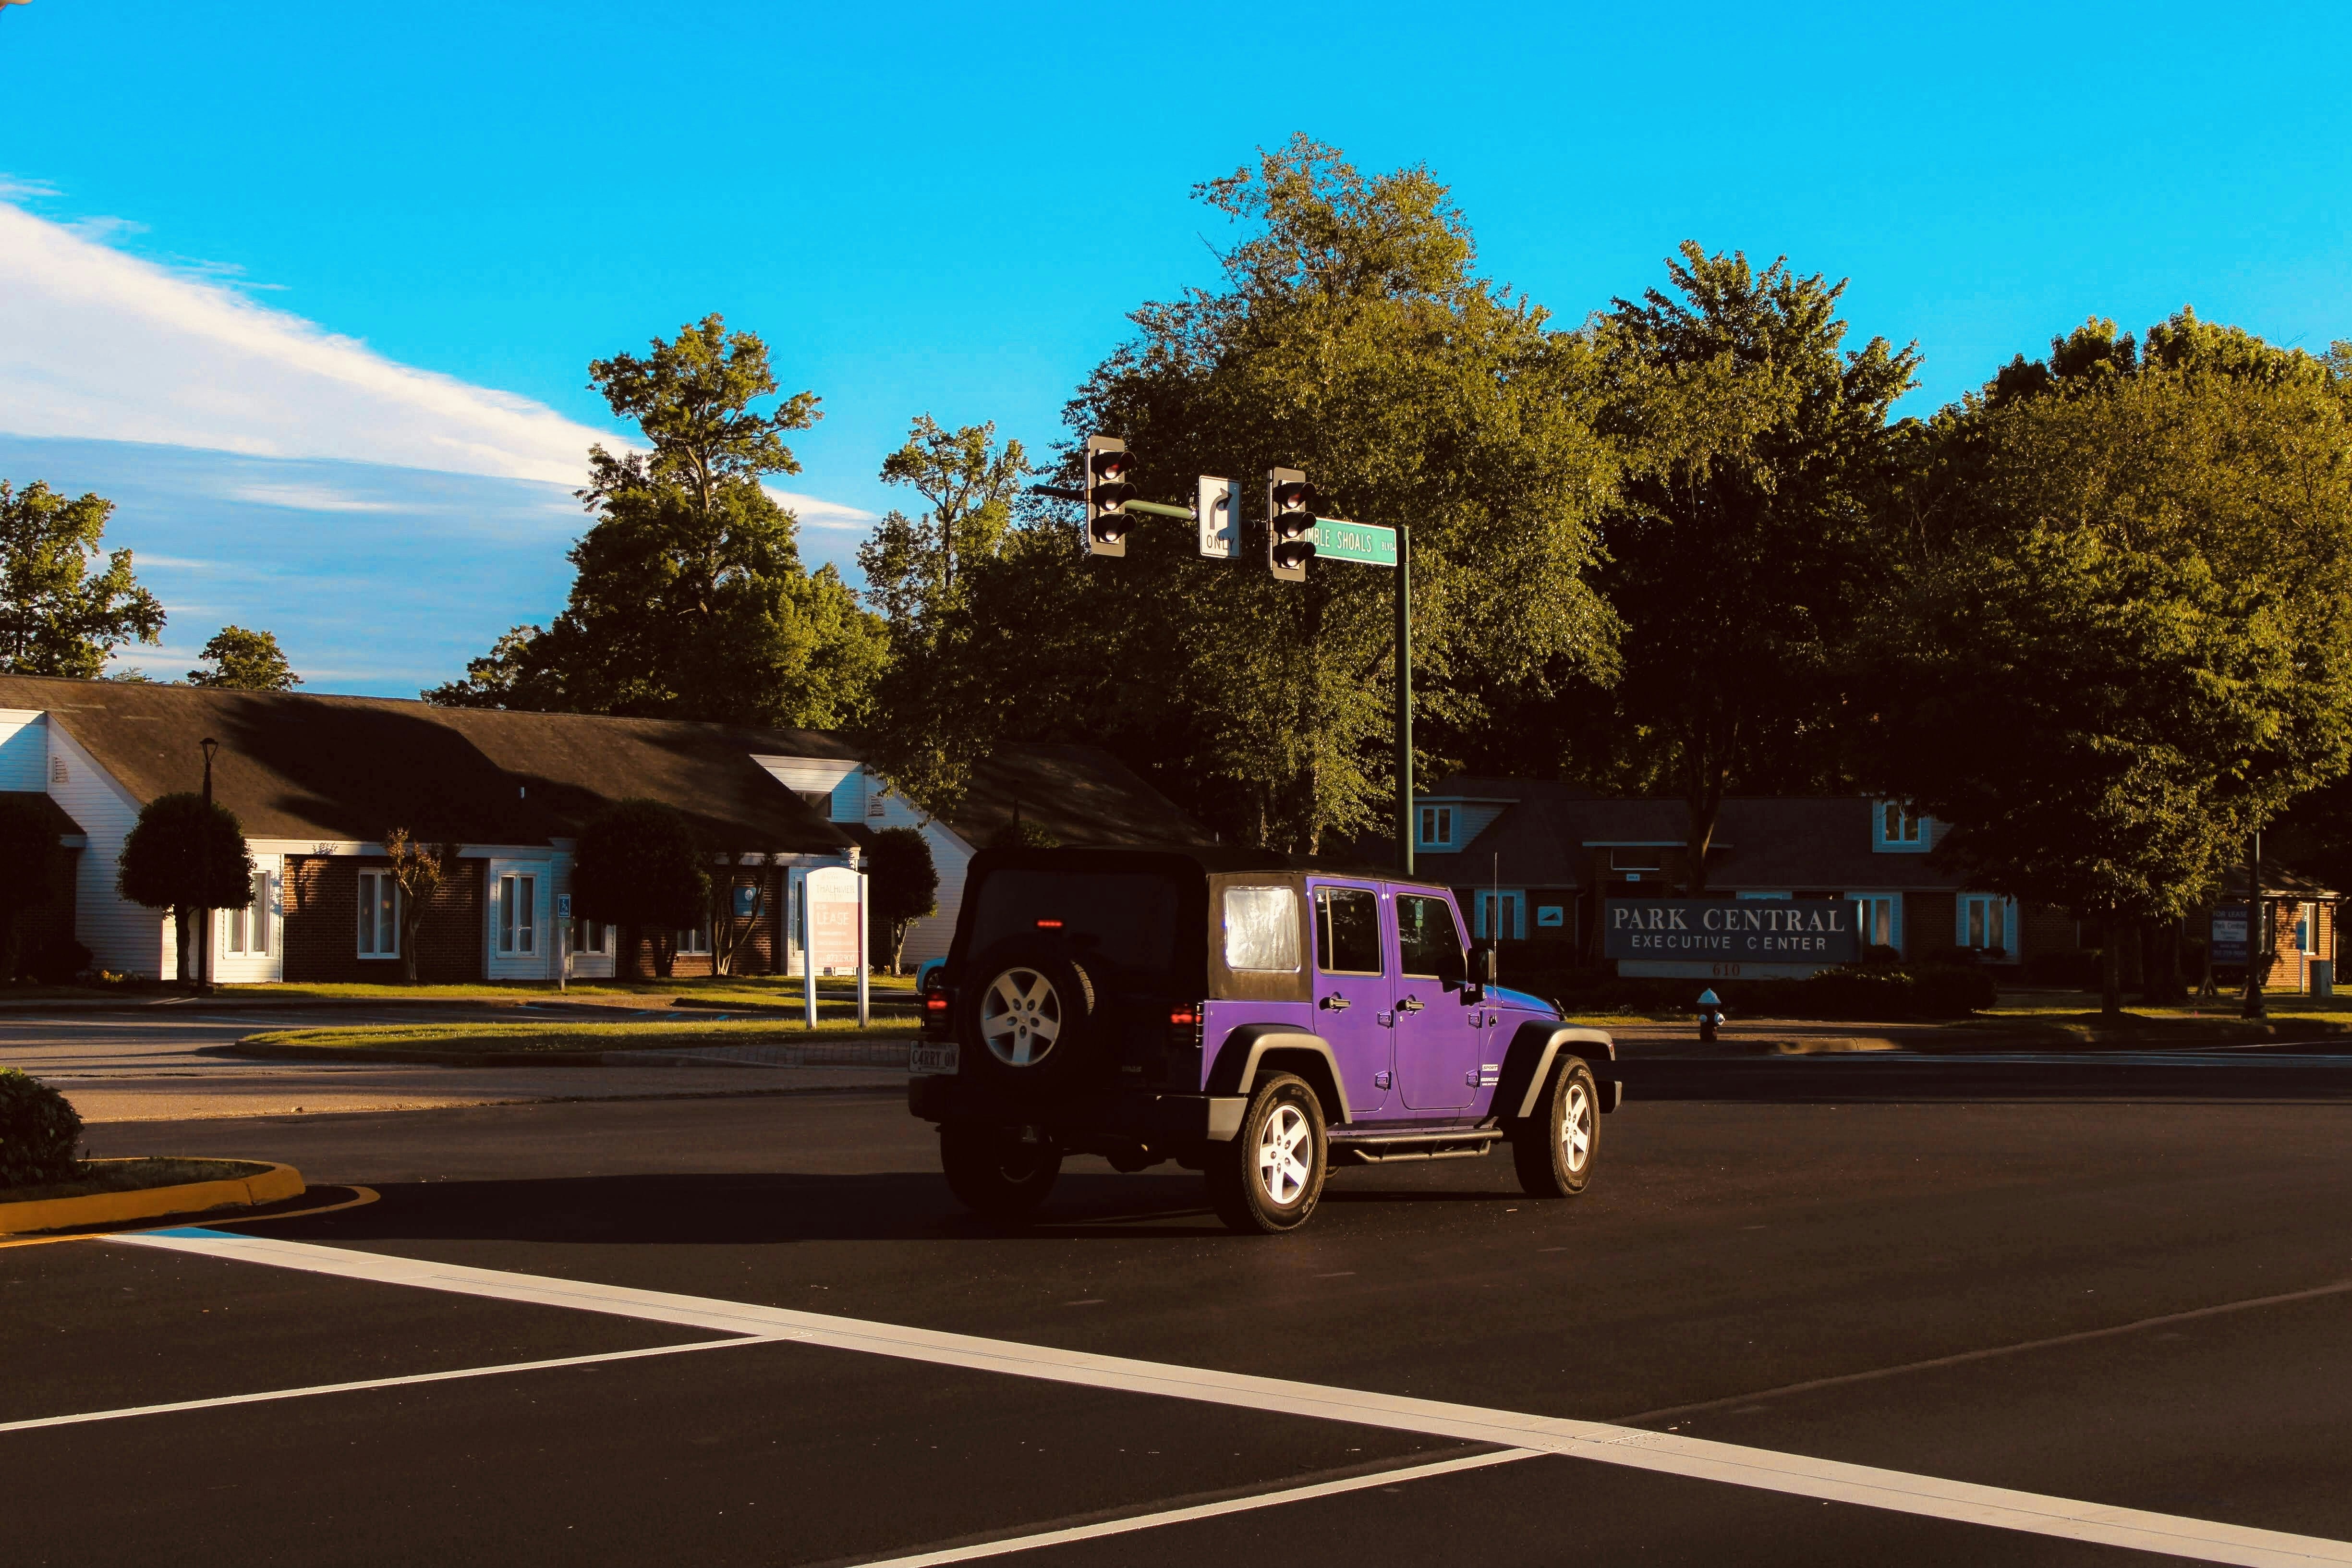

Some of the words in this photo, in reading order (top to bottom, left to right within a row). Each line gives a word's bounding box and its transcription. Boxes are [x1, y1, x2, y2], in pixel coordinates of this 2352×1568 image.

[1206, 534, 1235, 551] ONLY
[1337, 531, 1371, 553] SHOALS
[817, 912, 849, 925] LEASE
[1613, 908, 1687, 930] PARK
[1703, 909, 1845, 932] CENTRAL
[1632, 935, 1731, 949] EXECUTIVE
[1747, 936, 1826, 950] CENTER
[1712, 963, 1740, 976] 610
[945, 1051, 956, 1067] ON
